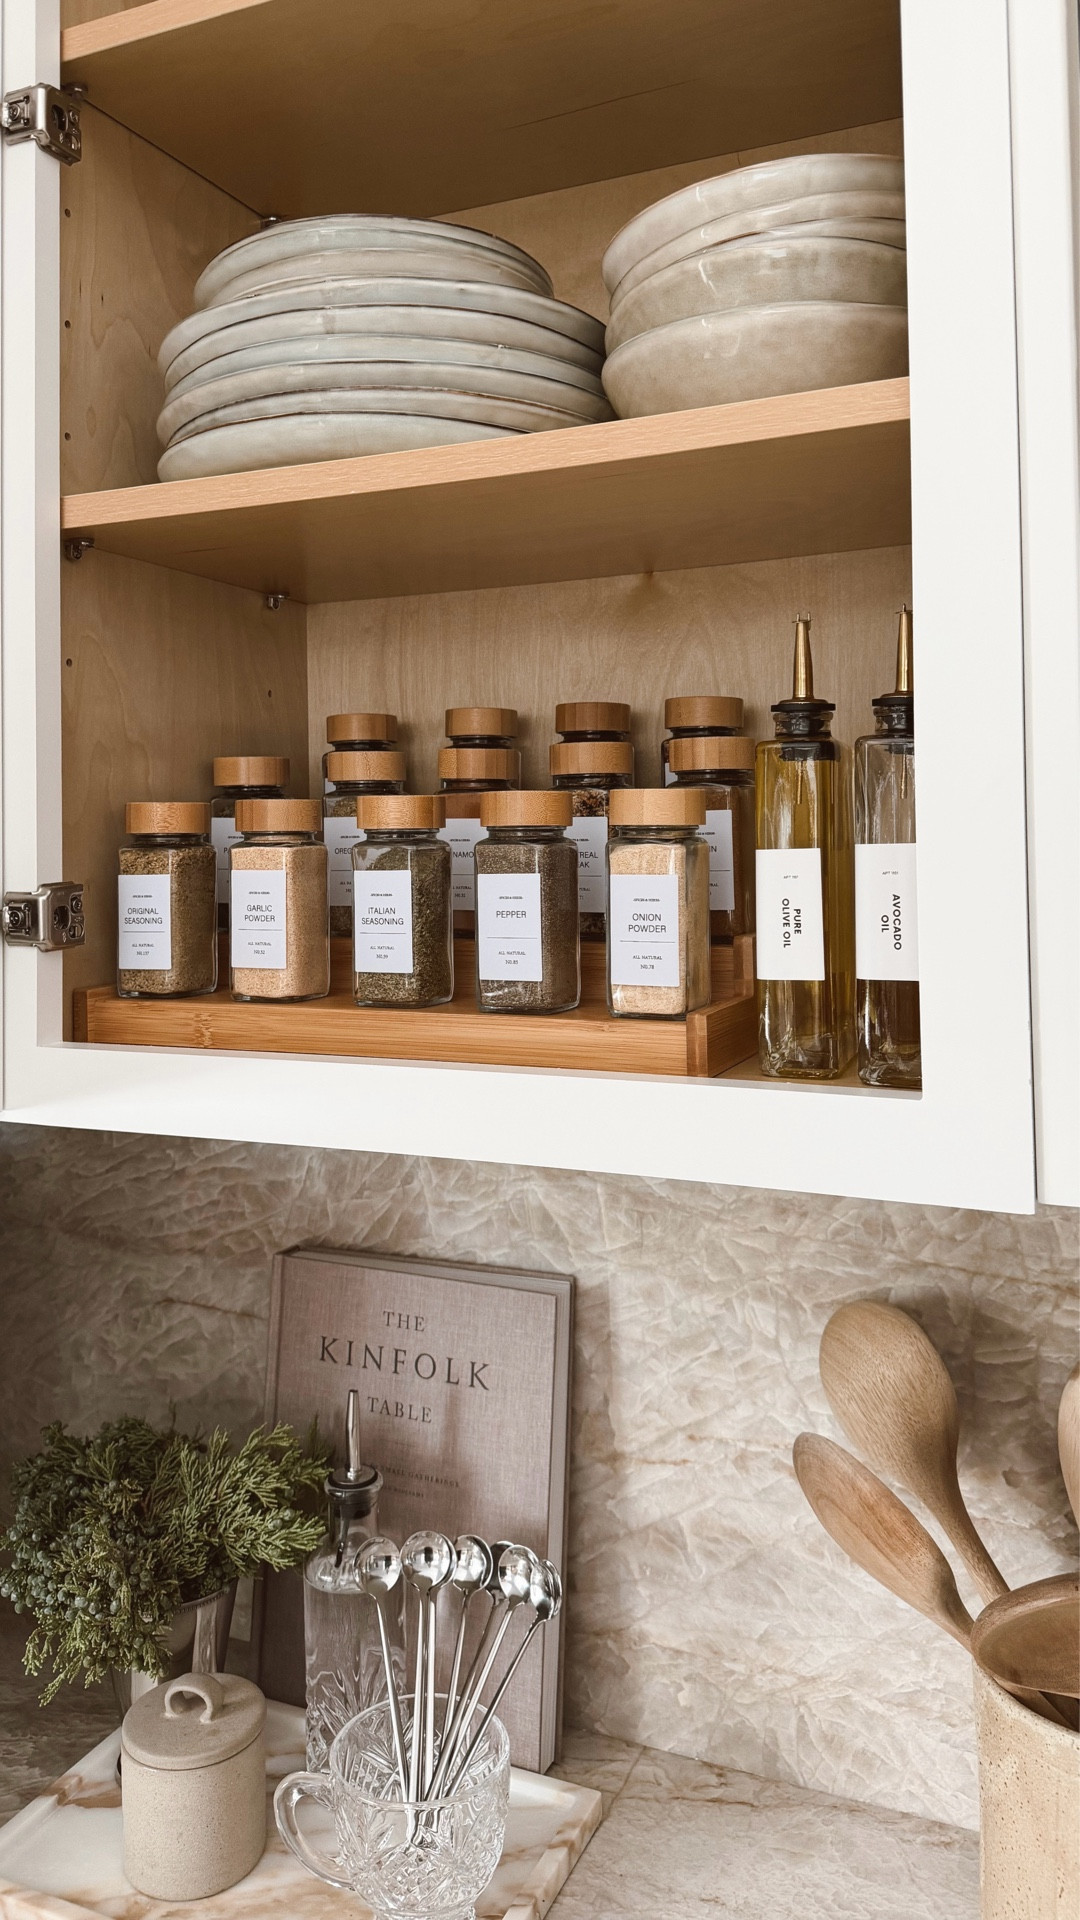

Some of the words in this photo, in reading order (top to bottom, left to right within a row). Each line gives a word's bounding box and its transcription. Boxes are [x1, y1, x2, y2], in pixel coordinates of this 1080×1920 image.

[334, 847, 352, 855] OREG
[452, 851, 475, 859] NAMO
[579, 851, 599, 859] REAL
[127, 907, 159, 915] ORIGINAL
[246, 904, 273, 912] GARLIC
[367, 907, 396, 915] ITALIAN
[495, 910, 527, 919] PEPPER
[632, 912, 662, 921] ONION
[782, 898, 791, 928] OLIVE
[124, 917, 163, 925] SEASONING
[244, 914, 276, 922] POWDER
[361, 917, 404, 925] SEASONING
[793, 908, 802, 935] PURE
[892, 893, 902, 951] AVOCADO
[881, 914, 890, 933] OIL
[628, 924, 667, 933] POWDER
[783, 931, 792, 948] OIL
[383, 1310, 426, 1332] THE
[320, 1335, 490, 1391] KINFOLK
[367, 1396, 432, 1424] TABLE
